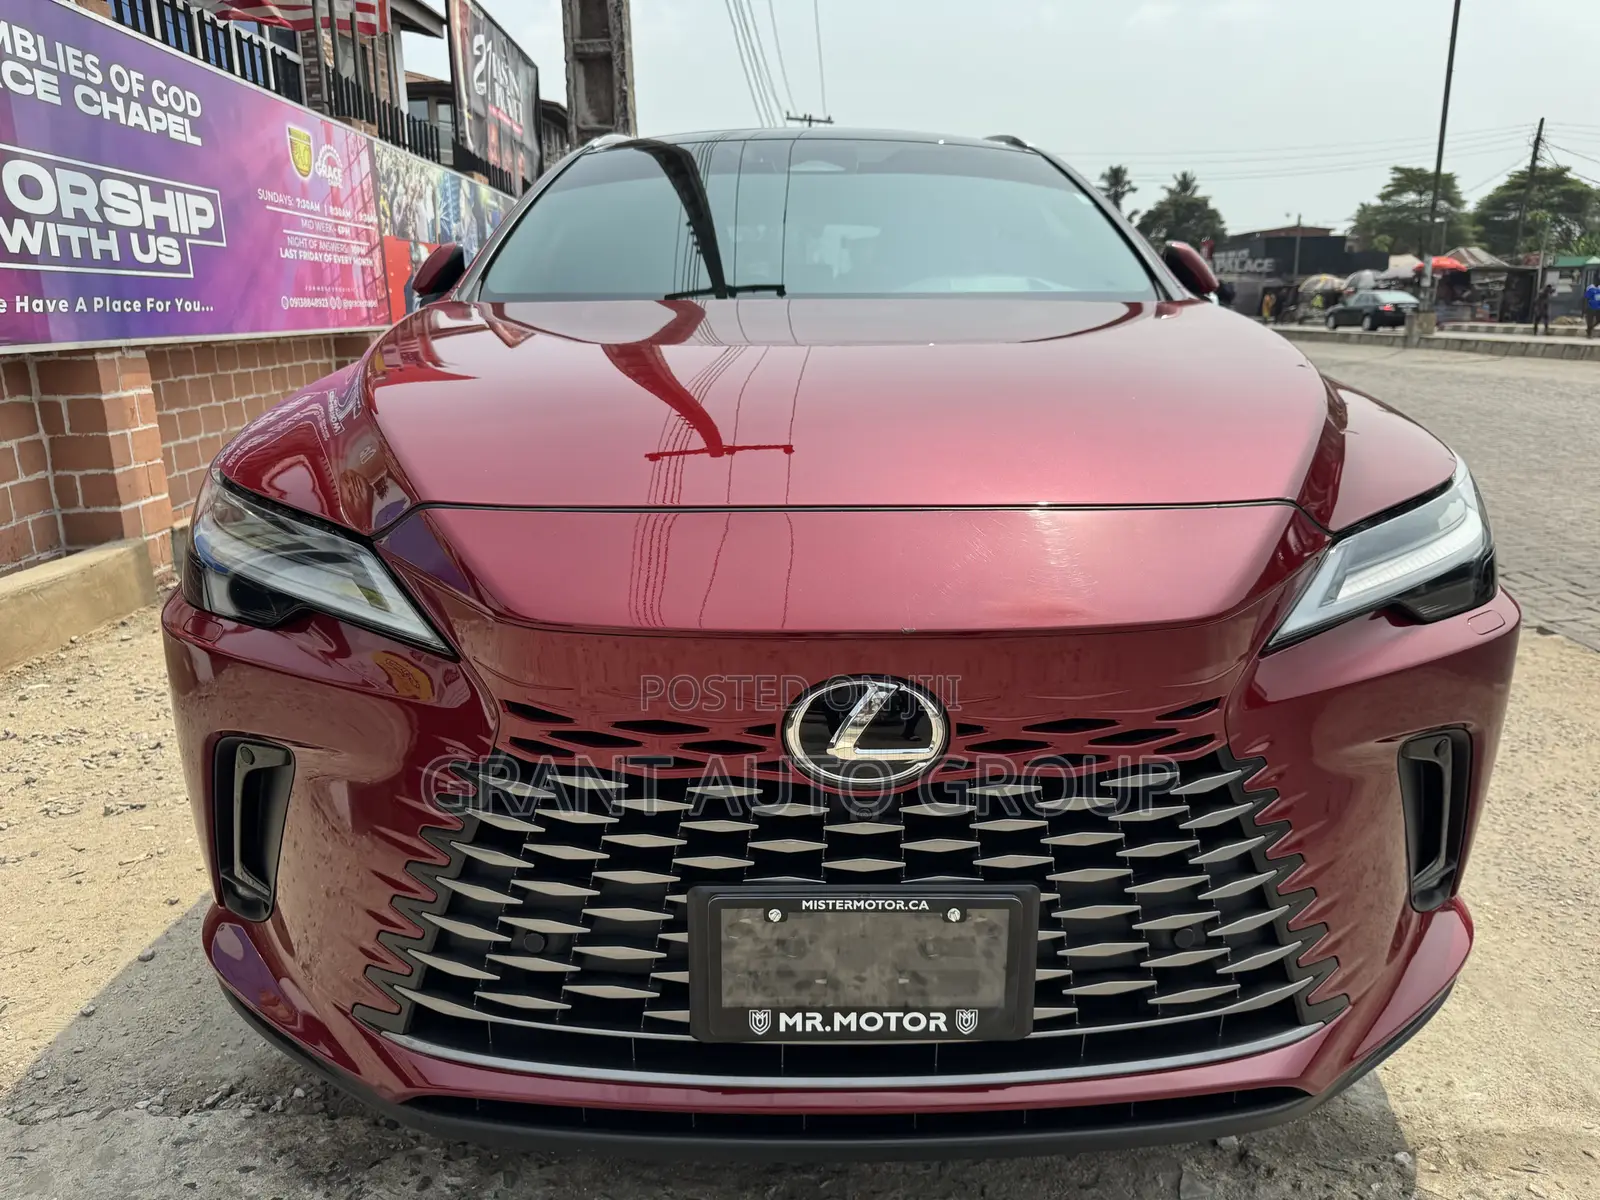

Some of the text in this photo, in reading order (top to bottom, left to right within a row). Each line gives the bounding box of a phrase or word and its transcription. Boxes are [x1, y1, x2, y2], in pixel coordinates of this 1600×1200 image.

[109, 64, 145, 98] OF
[151, 79, 202, 118] GOD
[0, 60, 202, 147] CE CHAPEL
[2, 159, 215, 236] ORSHIP
[257, 188, 295, 206] SUNDAYS:
[0, 216, 182, 266] WITH US
[308, 238, 318, 249] OF
[280, 248, 298, 260] LAST
[299, 250, 323, 263] FRIDAY
[323, 253, 333, 263] OF
[333, 254, 353, 266] EVERY
[15, 295, 69, 313] Have
[74, 297, 88, 313] A
[93, 296, 141, 313] Place
[147, 297, 171, 313] For
[174, 297, 214, 312] You...
[801, 899, 930, 911] MISTERMOTOR.CA
[779, 1011, 948, 1033] MR.MOTOR
